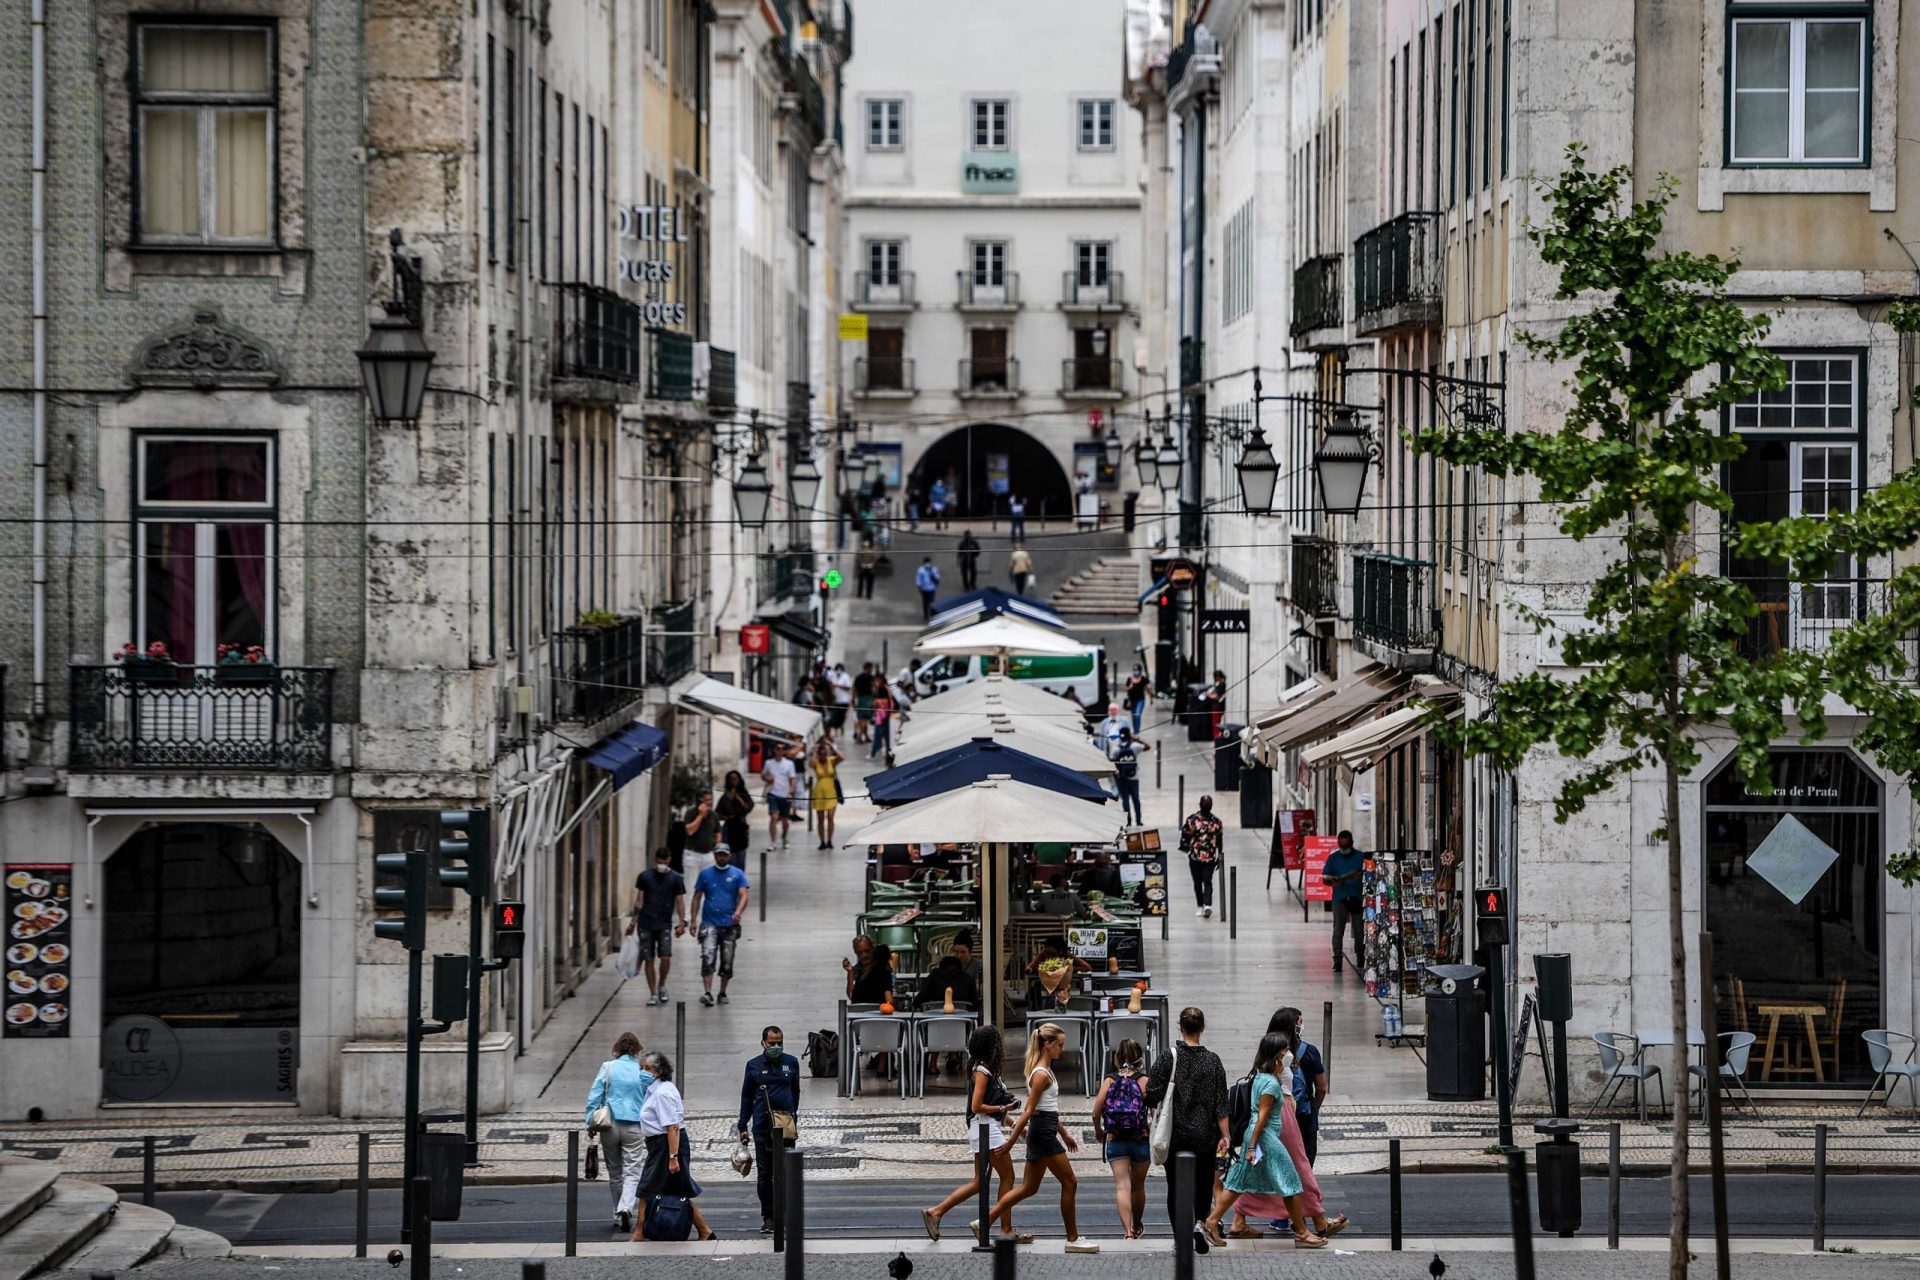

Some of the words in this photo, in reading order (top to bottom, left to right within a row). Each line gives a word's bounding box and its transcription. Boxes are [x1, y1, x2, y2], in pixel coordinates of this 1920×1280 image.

[965, 162, 1016, 182] fnac
[638, 293, 687, 324] ões
[1201, 620, 1246, 630] ZARA
[1744, 785, 1786, 796] Cca
[1790, 785, 1804, 796] de
[1807, 785, 1838, 797] Prata
[1080, 930, 1096, 938] HOJE
[107, 1060, 170, 1076] ALDEA
[277, 1047, 292, 1092] SAGRES
